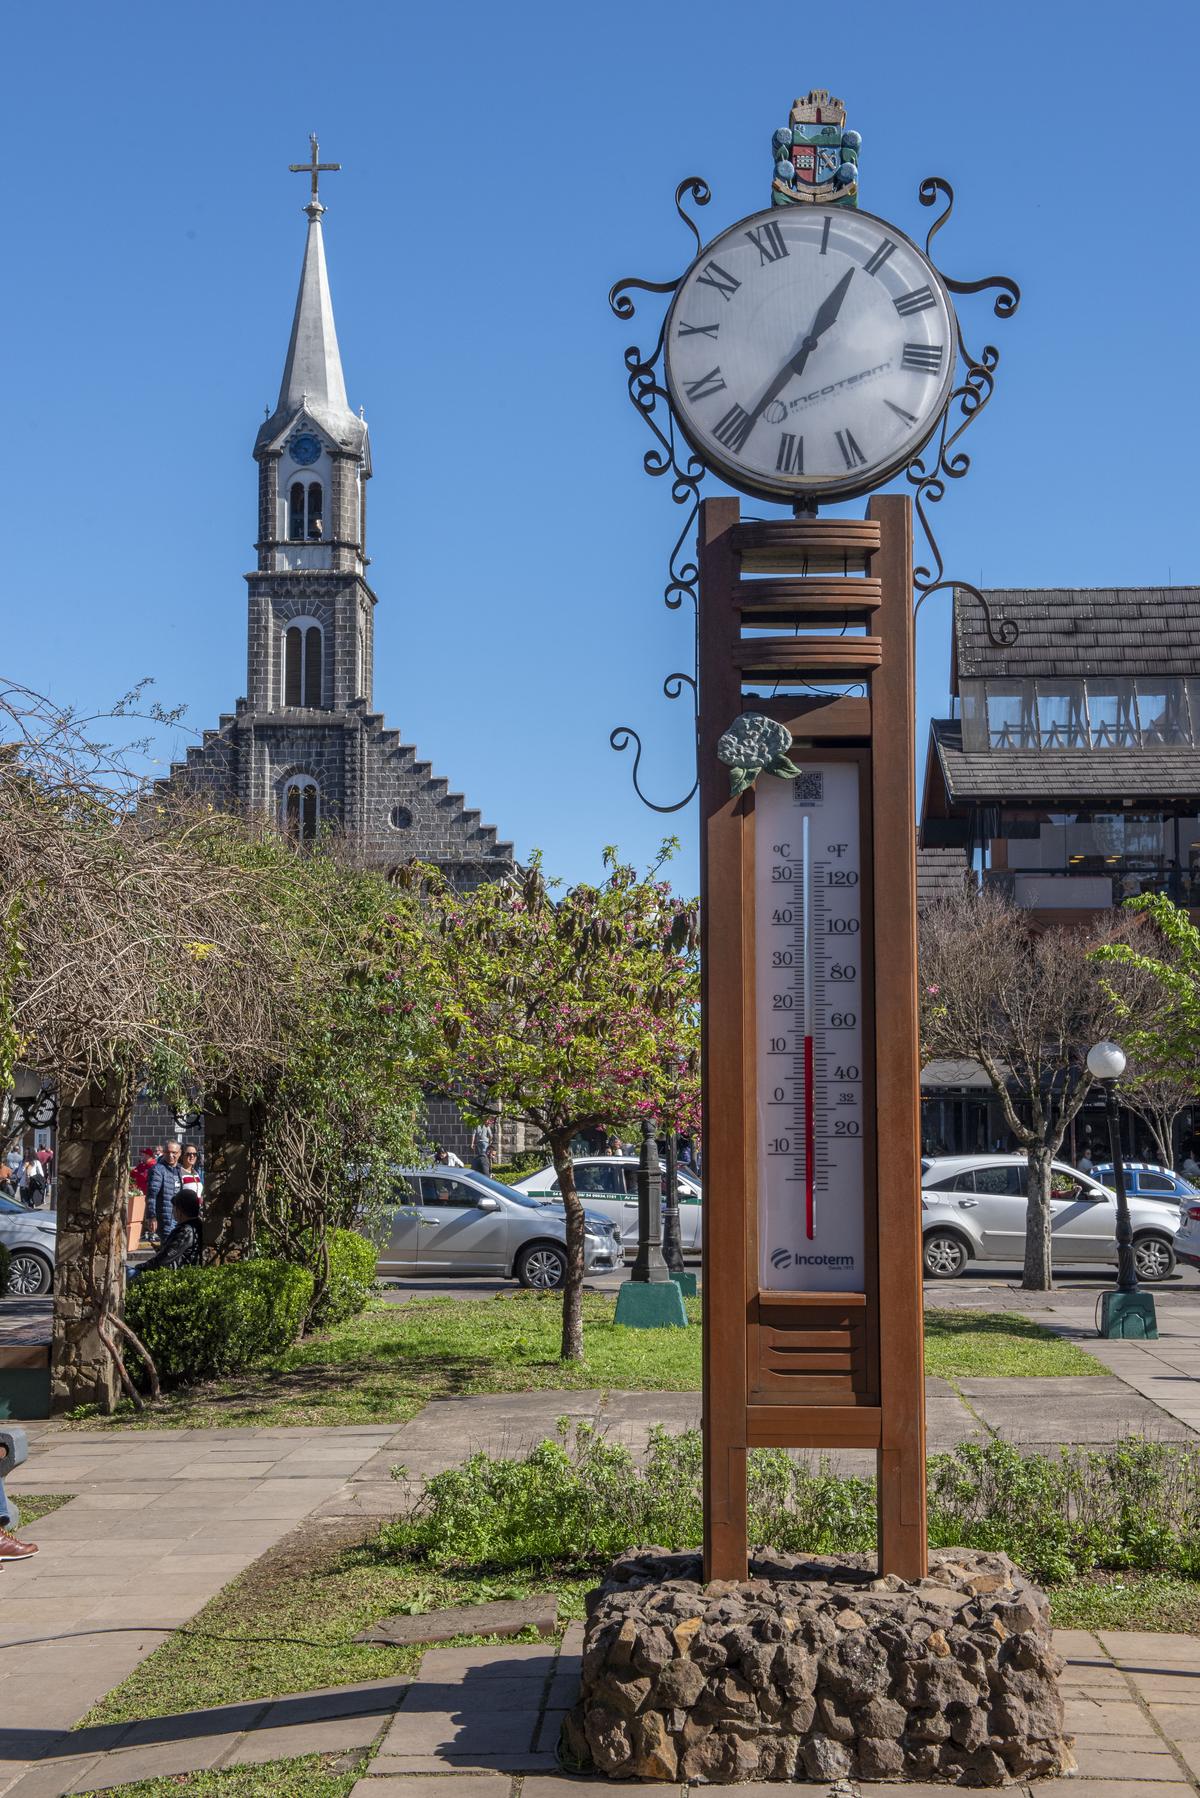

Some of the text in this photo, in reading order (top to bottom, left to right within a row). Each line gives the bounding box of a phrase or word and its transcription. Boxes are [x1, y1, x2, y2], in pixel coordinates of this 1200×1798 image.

[744, 220, 790, 267] XII
[862, 237, 898, 277] II
[696, 260, 743, 302] XI
[892, 284, 937, 317] III
[678, 320, 720, 340] X
[682, 366, 728, 404] IX
[775, 432, 805, 475] VII
[835, 428, 868, 470] VI
[772, 866, 793, 881] 50
[827, 871, 859, 885] 120
[772, 909, 793, 923] 40
[827, 918, 860, 933] 100
[772, 951, 793, 966] 30
[830, 964, 857, 980] 80
[773, 994, 793, 1009] 20
[830, 1013, 857, 1027] 60
[771, 1037, 786, 1052] 10
[834, 1065, 859, 1080] 40
[774, 1087, 785, 1102] 0
[839, 1093, 854, 1102] 32
[834, 1120, 860, 1136] 20
[767, 1138, 789, 1153] -10
[794, 1252, 855, 1266] Incoterm
